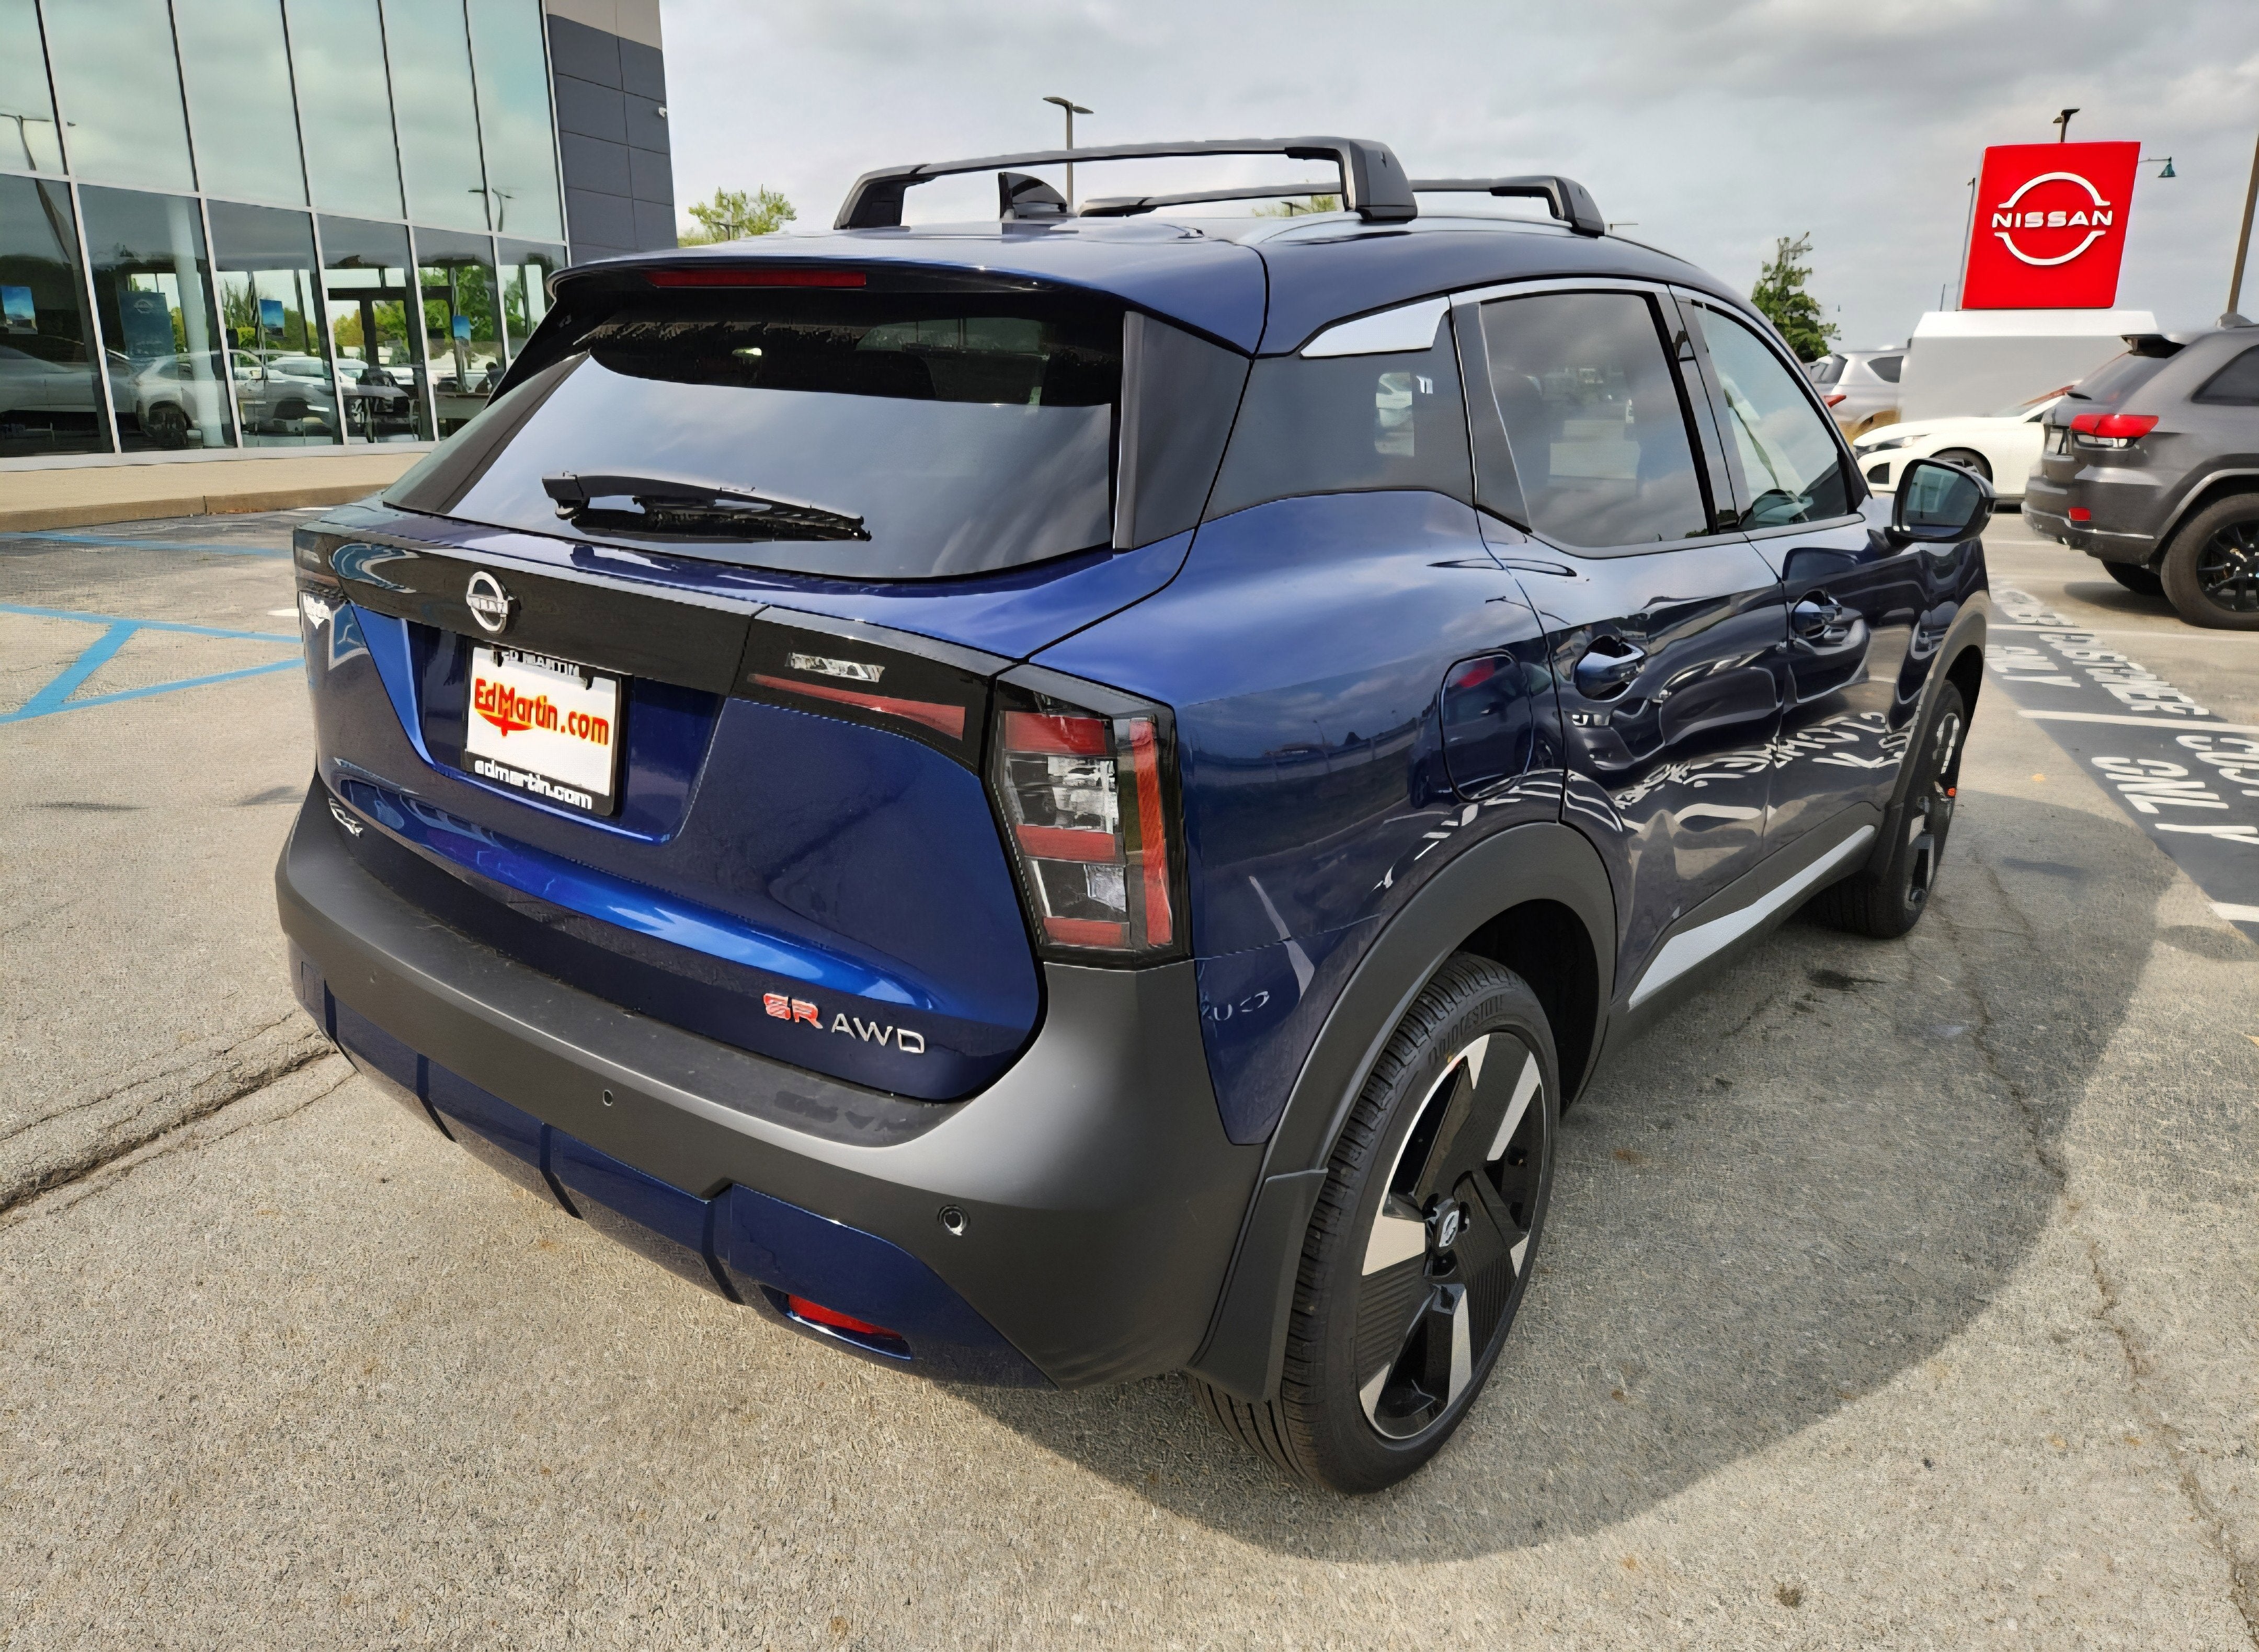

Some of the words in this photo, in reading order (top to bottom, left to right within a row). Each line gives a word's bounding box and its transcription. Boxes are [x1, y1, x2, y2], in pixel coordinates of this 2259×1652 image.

[1991, 210, 2113, 228] NISSAN
[474, 678, 609, 746] EdMartin.com
[474, 759, 593, 810] edmartin.com
[830, 1013, 925, 1054] AWD
